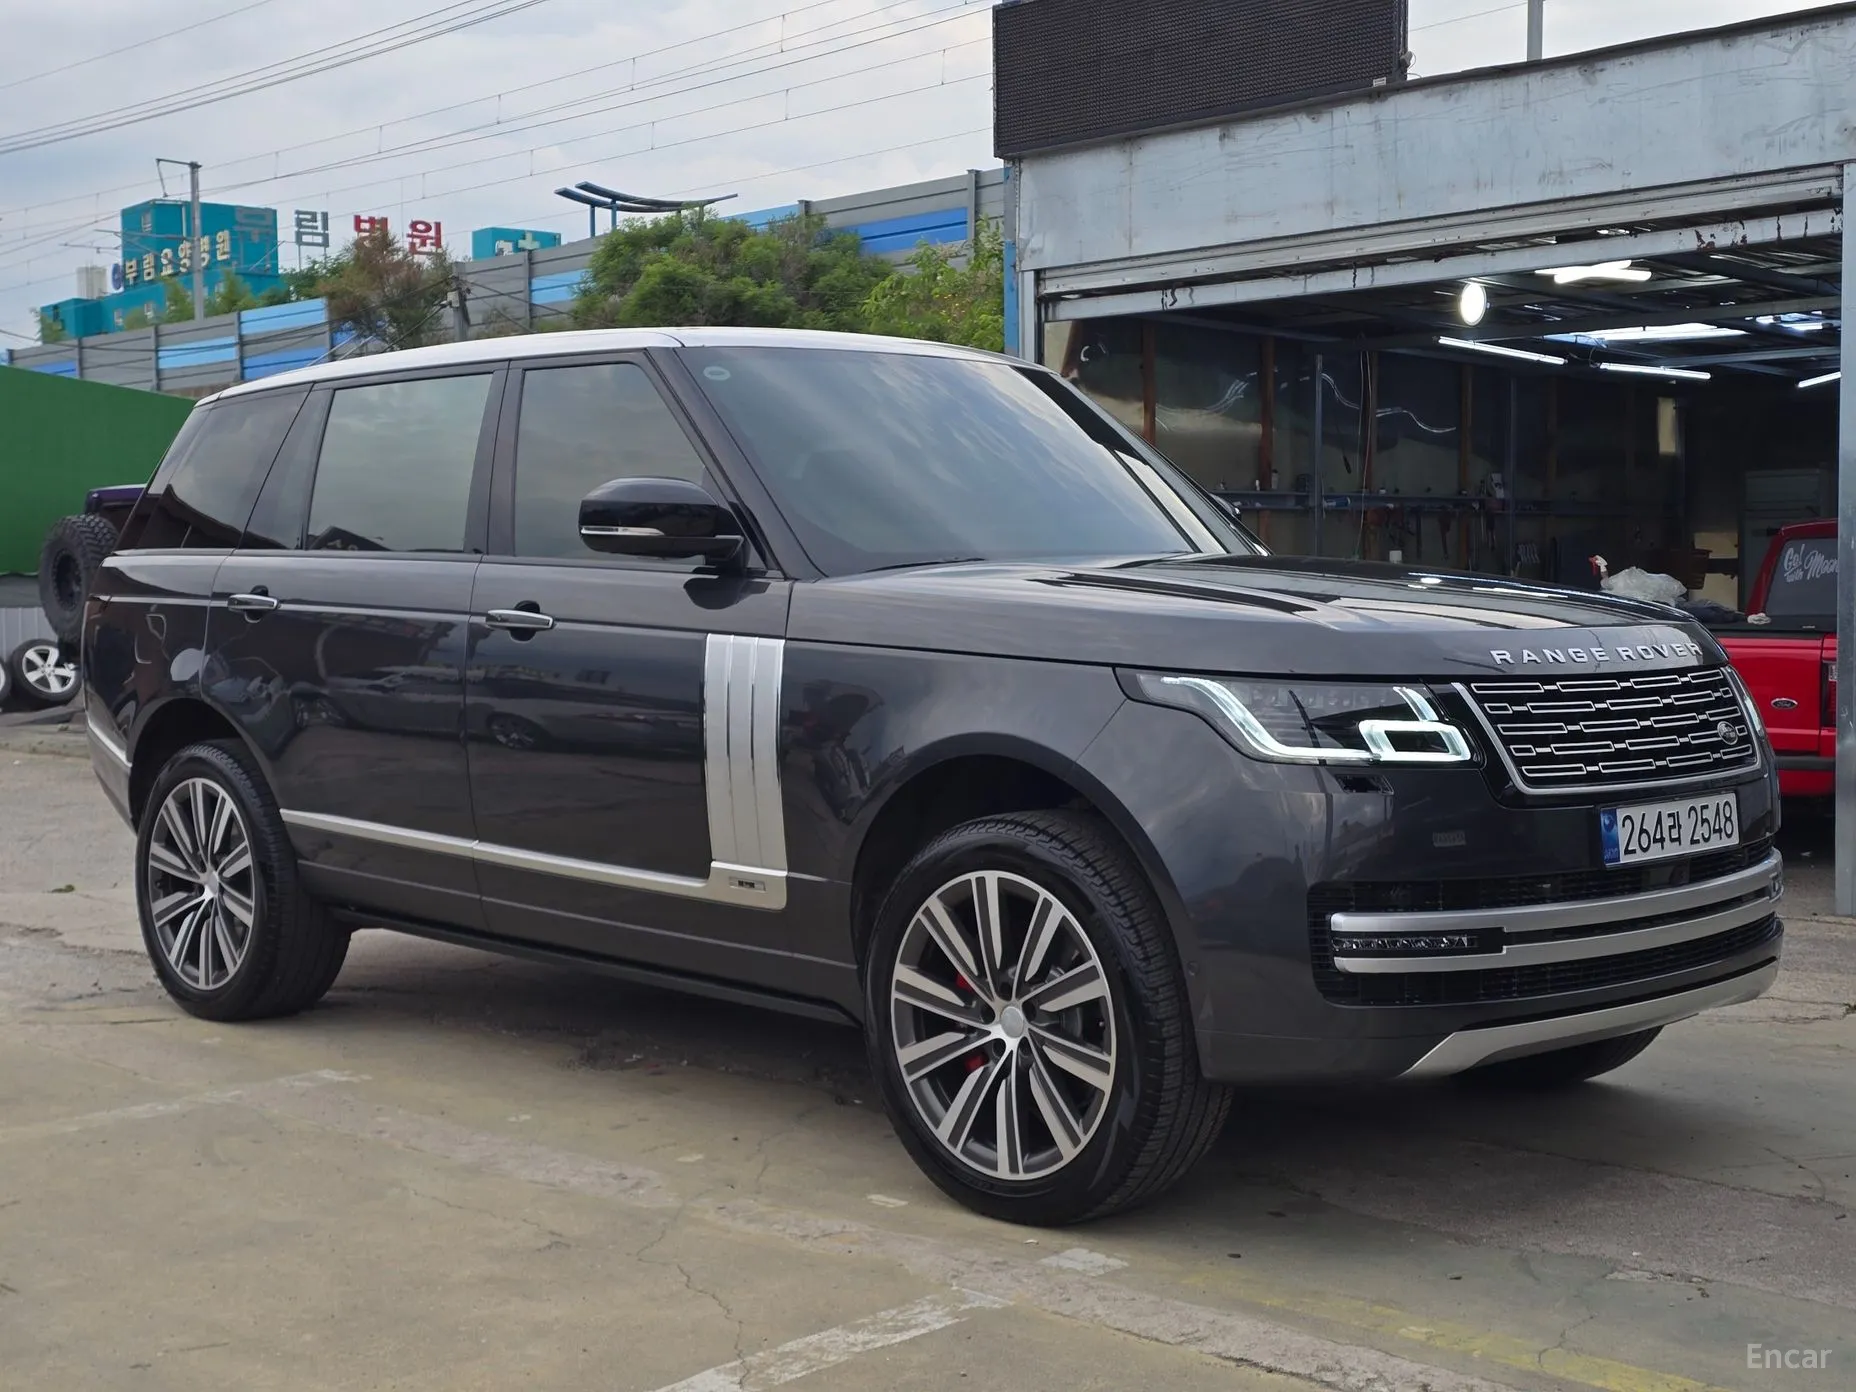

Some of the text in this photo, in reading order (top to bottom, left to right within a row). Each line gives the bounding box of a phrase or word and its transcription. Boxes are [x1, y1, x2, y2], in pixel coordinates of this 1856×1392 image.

[1490, 642, 1703, 665] RANGE ROVER
[1621, 801, 1734, 856] 264라 2548
